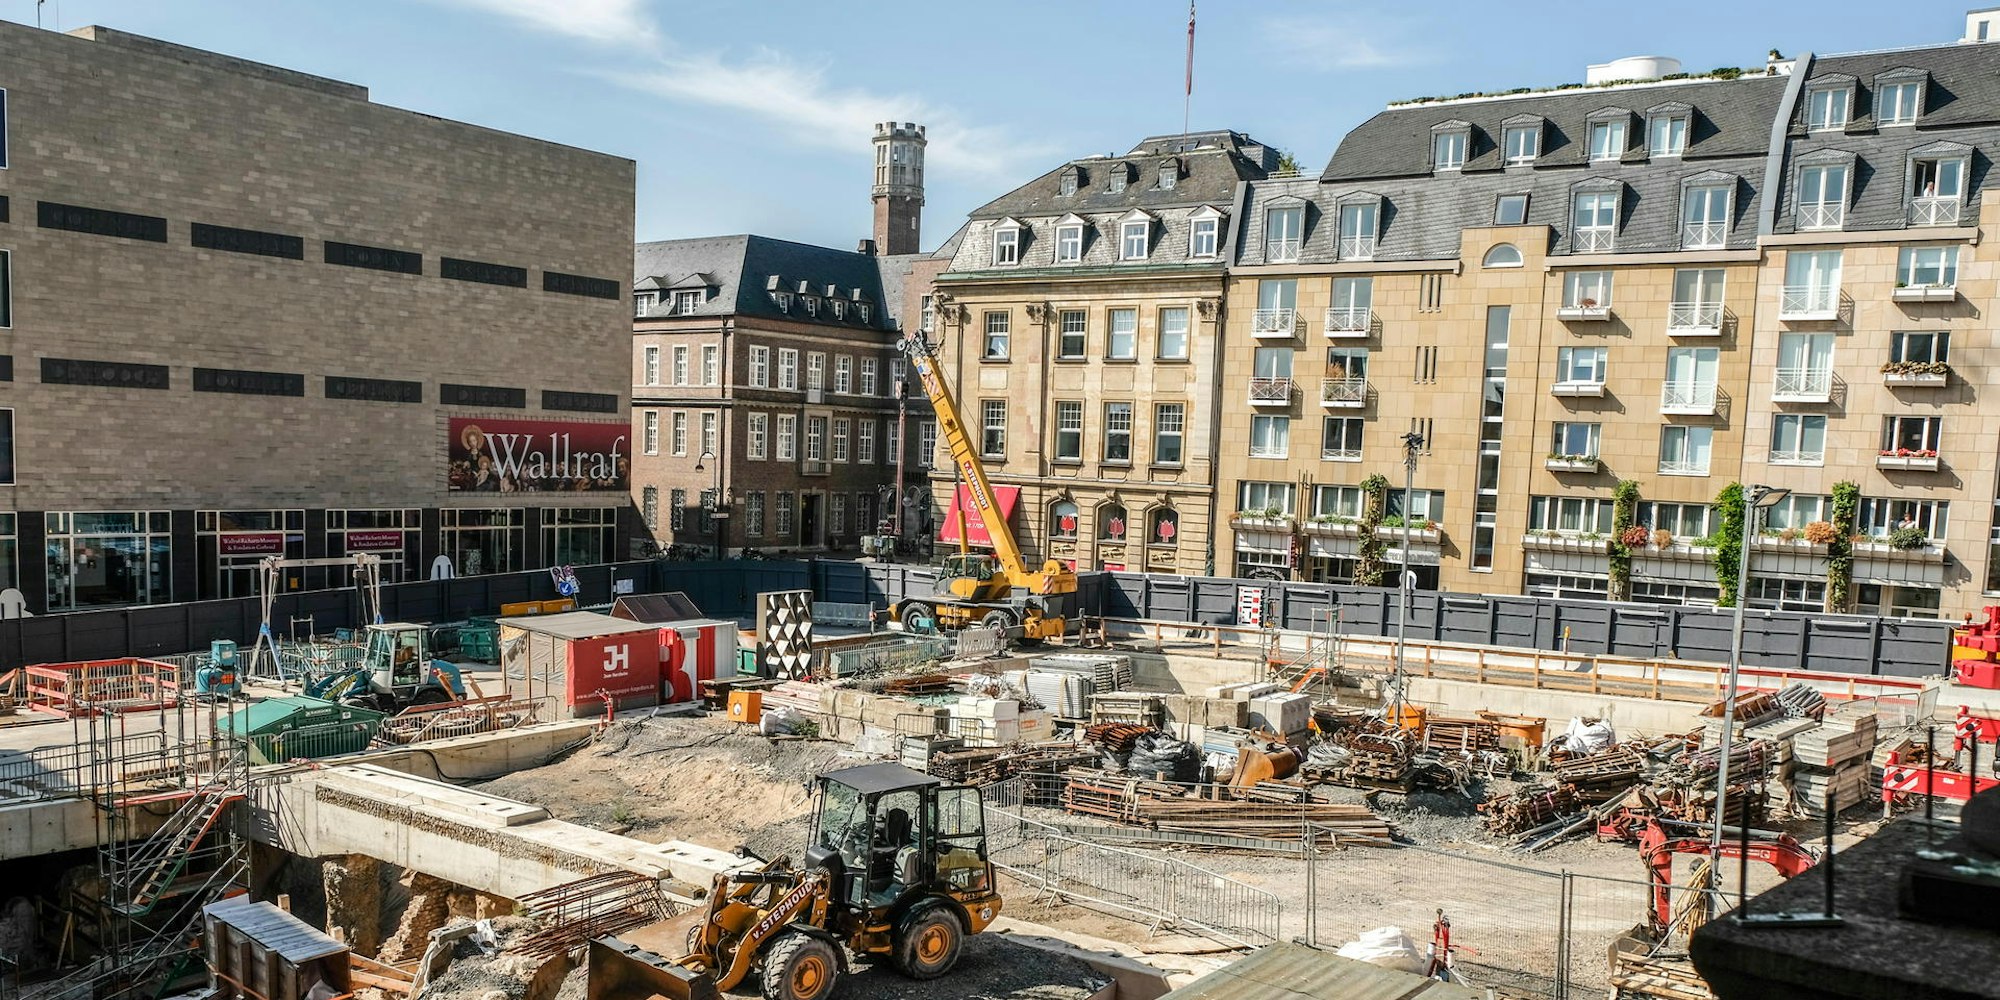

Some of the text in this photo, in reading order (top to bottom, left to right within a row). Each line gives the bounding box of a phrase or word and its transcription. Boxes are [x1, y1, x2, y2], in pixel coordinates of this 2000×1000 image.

[483, 432, 625, 480] Wallraf
[603, 643, 629, 672] JH
[950, 872, 970, 887] CAT
[753, 882, 818, 939] v.STEPHOUD
